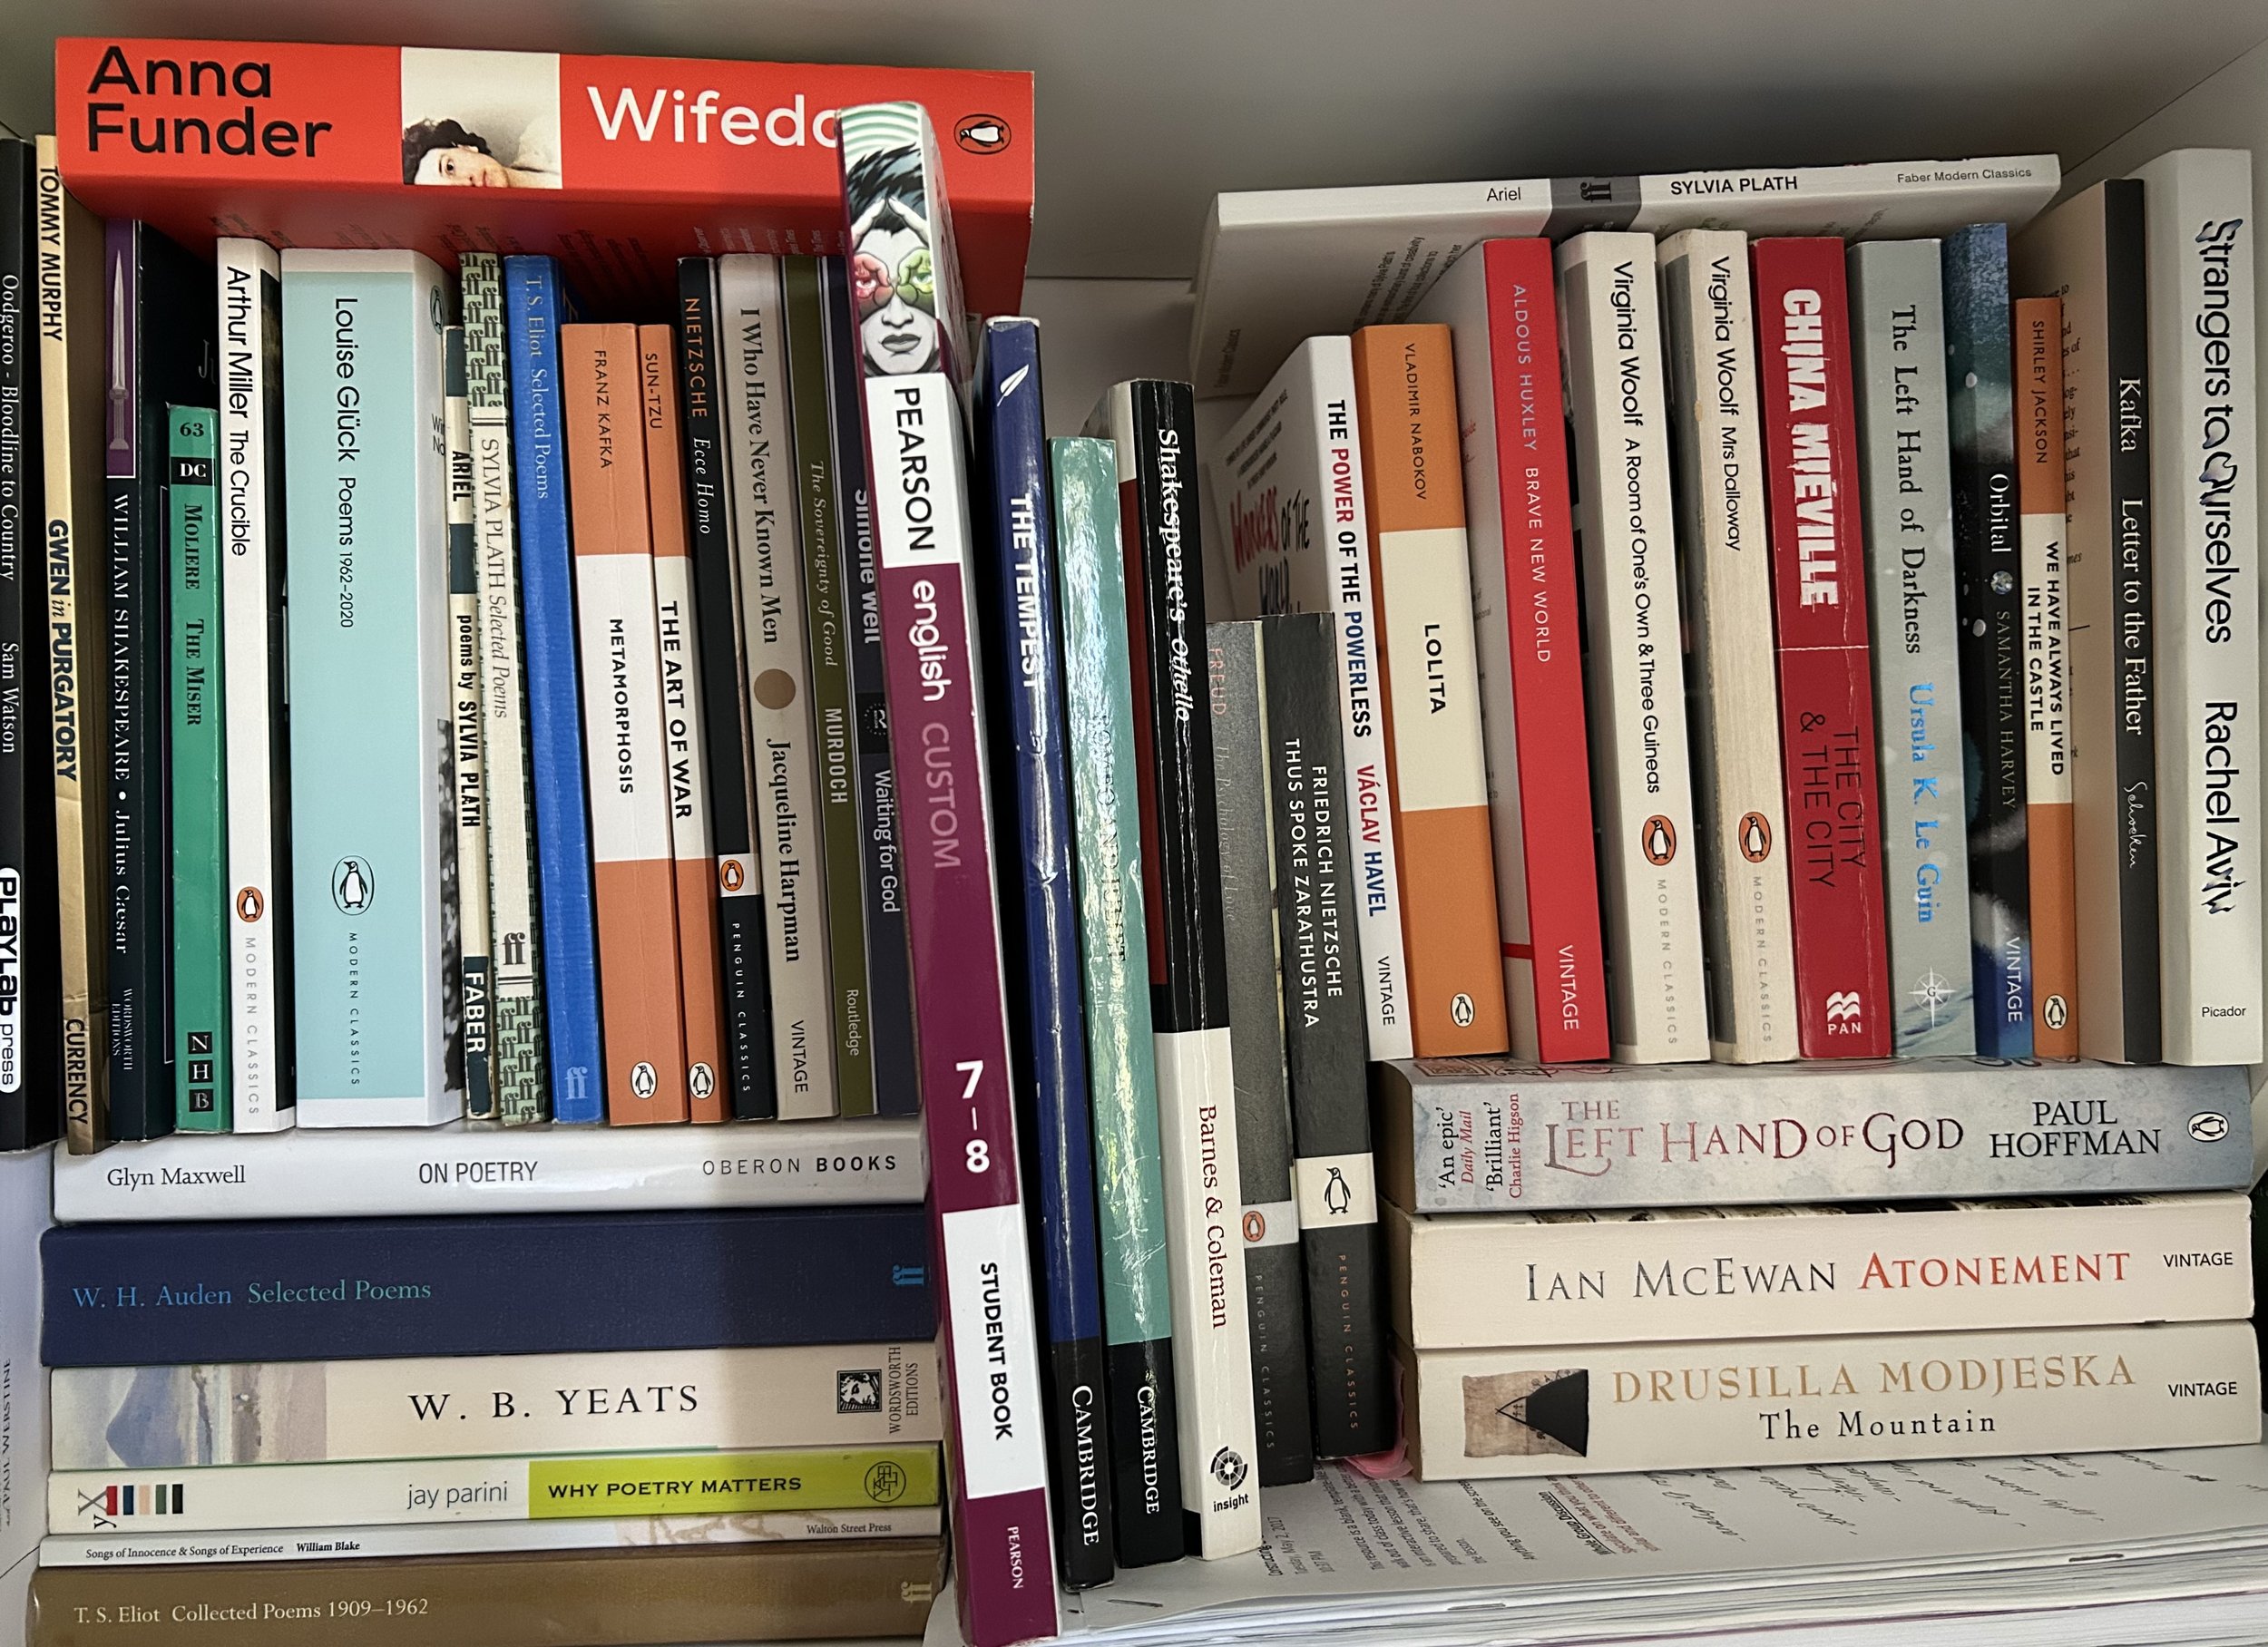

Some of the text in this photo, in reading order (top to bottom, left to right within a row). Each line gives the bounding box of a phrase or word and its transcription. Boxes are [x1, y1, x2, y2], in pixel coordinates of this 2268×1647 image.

[88, 46, 270, 98] Anna
[88, 102, 332, 157] Funder
[586, 86, 836, 148] Wifedo
[1487, 187, 1520, 201] Ariel
[1671, 176, 1797, 195] SYLVIA PLATH
[1898, 170, 2031, 183] Faber Modern Classics
[41, 165, 62, 341] TOMMY MURPHY
[335, 297, 357, 379] Louise
[181, 423, 204, 436] 63
[227, 265, 254, 556] Arthur Miller The Crucible
[337, 386, 360, 462] Glück
[594, 350, 613, 469] FRANZ KAFKA
[646, 354, 662, 428] SUN-TZU
[685, 298, 714, 533] NIETZSCHE Ecce Homo
[1405, 344, 1426, 499] VLADIMIR NABOKOV
[1708, 257, 1741, 551] Virginia Woolf Mrs Dalloway
[2032, 321, 2048, 463] SHIRLEY JACKSON
[181, 463, 206, 477] DC
[452, 450, 472, 502] ARIEL
[894, 388, 935, 551] PEARSON
[1514, 285, 1550, 661] ALDOUS HUXLEY BRAVE NEW WORLD
[1781, 288, 1838, 605] CHINA MIEVILLE
[338, 478, 356, 545] Poems
[1989, 474, 2011, 551] Orbital
[2120, 377, 2146, 735] Kafka Letter to the Father
[48, 520, 77, 783] GWEN in PURGATORY
[909, 580, 952, 701] english
[1892, 305, 1940, 922] The Left Hand of Darkness Ursula K. Le Guin
[2, 643, 19, 753] Sam Watson
[610, 619, 633, 794] METAMORPHOSIS
[1425, 624, 1445, 714] LOLITA
[457, 614, 480, 828] poems by SYLVIA PLATH
[661, 600, 691, 818] THE ART OF WAR
[826, 709, 847, 803] MURDOCH
[922, 723, 960, 868] CUSTOM
[767, 738, 799, 962] Jacqueline Harpman
[874, 770, 900, 912] Waiting for God
[1357, 765, 1386, 917] VÁCLAV HAVEL
[1313, 765, 1343, 996] FRIEDRICH NIETZSCHE
[349, 933, 359, 1084] MODERN CLASSICS
[464, 972, 485, 1054] FABER
[1378, 956, 1394, 1026] VINTAGE
[1559, 945, 1579, 1029] VINTAGE
[2006, 937, 2023, 1023] VINTAGE
[2202, 1007, 2246, 1017] Picador
[112, 1004, 121, 1056] EDITIONS
[123, 989, 132, 1069] WORDSWORTH
[791, 1020, 808, 1093] VINTAGE
[846, 989, 862, 1056] Routledge
[1828, 1022, 1861, 1035] PAN
[65, 1018, 88, 1125] CURRENCY
[1459, 1111, 1476, 1184] Daily Mail
[1508, 1094, 1523, 1198] Charlie Higson
[1989, 1129, 2161, 1157] HOFFMAN
[2032, 1100, 2117, 1126] PAUL
[108, 1165, 246, 1190] Glyn Maxwell
[419, 1161, 538, 1184] ON POETRY
[702, 1155, 895, 1176] OBERON BOOKS
[1199, 1105, 1227, 1330] Barnes & Coleman
[73, 1280, 431, 1308] W. H. Auden Selected Poems
[2164, 1252, 2233, 1267] VINTAGE
[905, 1363, 918, 1416] EDITIONS
[981, 1262, 1012, 1440] STUDENT BOOK
[1613, 1355, 2136, 1403] DRUSILLA MODJESKA
[407, 1386, 697, 1420] W. B. YEATS
[889, 1347, 901, 1434] WORDSWORTH
[1759, 1408, 1995, 1439] The Mountain
[548, 1476, 802, 1498] WHY POETRY MATTERS
[1072, 1386, 1099, 1545] CAMBRIDGE
[1137, 1386, 1159, 1515] CAMBRIDGE
[407, 1482, 506, 1509] jay parini
[807, 1524, 892, 1534] Walton Street Press
[1214, 1494, 1248, 1512] insight
[86, 1545, 283, 1561] Songs of Innocence & Songs of Experience
[297, 1541, 360, 1552] William Blake
[1008, 1526, 1023, 1588] PEARSON
[74, 1607, 90, 1623] T.
[97, 1607, 112, 1623] S.
[119, 1605, 160, 1622] Eliot
[172, 1603, 257, 1622] Collected
[264, 1603, 320, 1619] Poems
